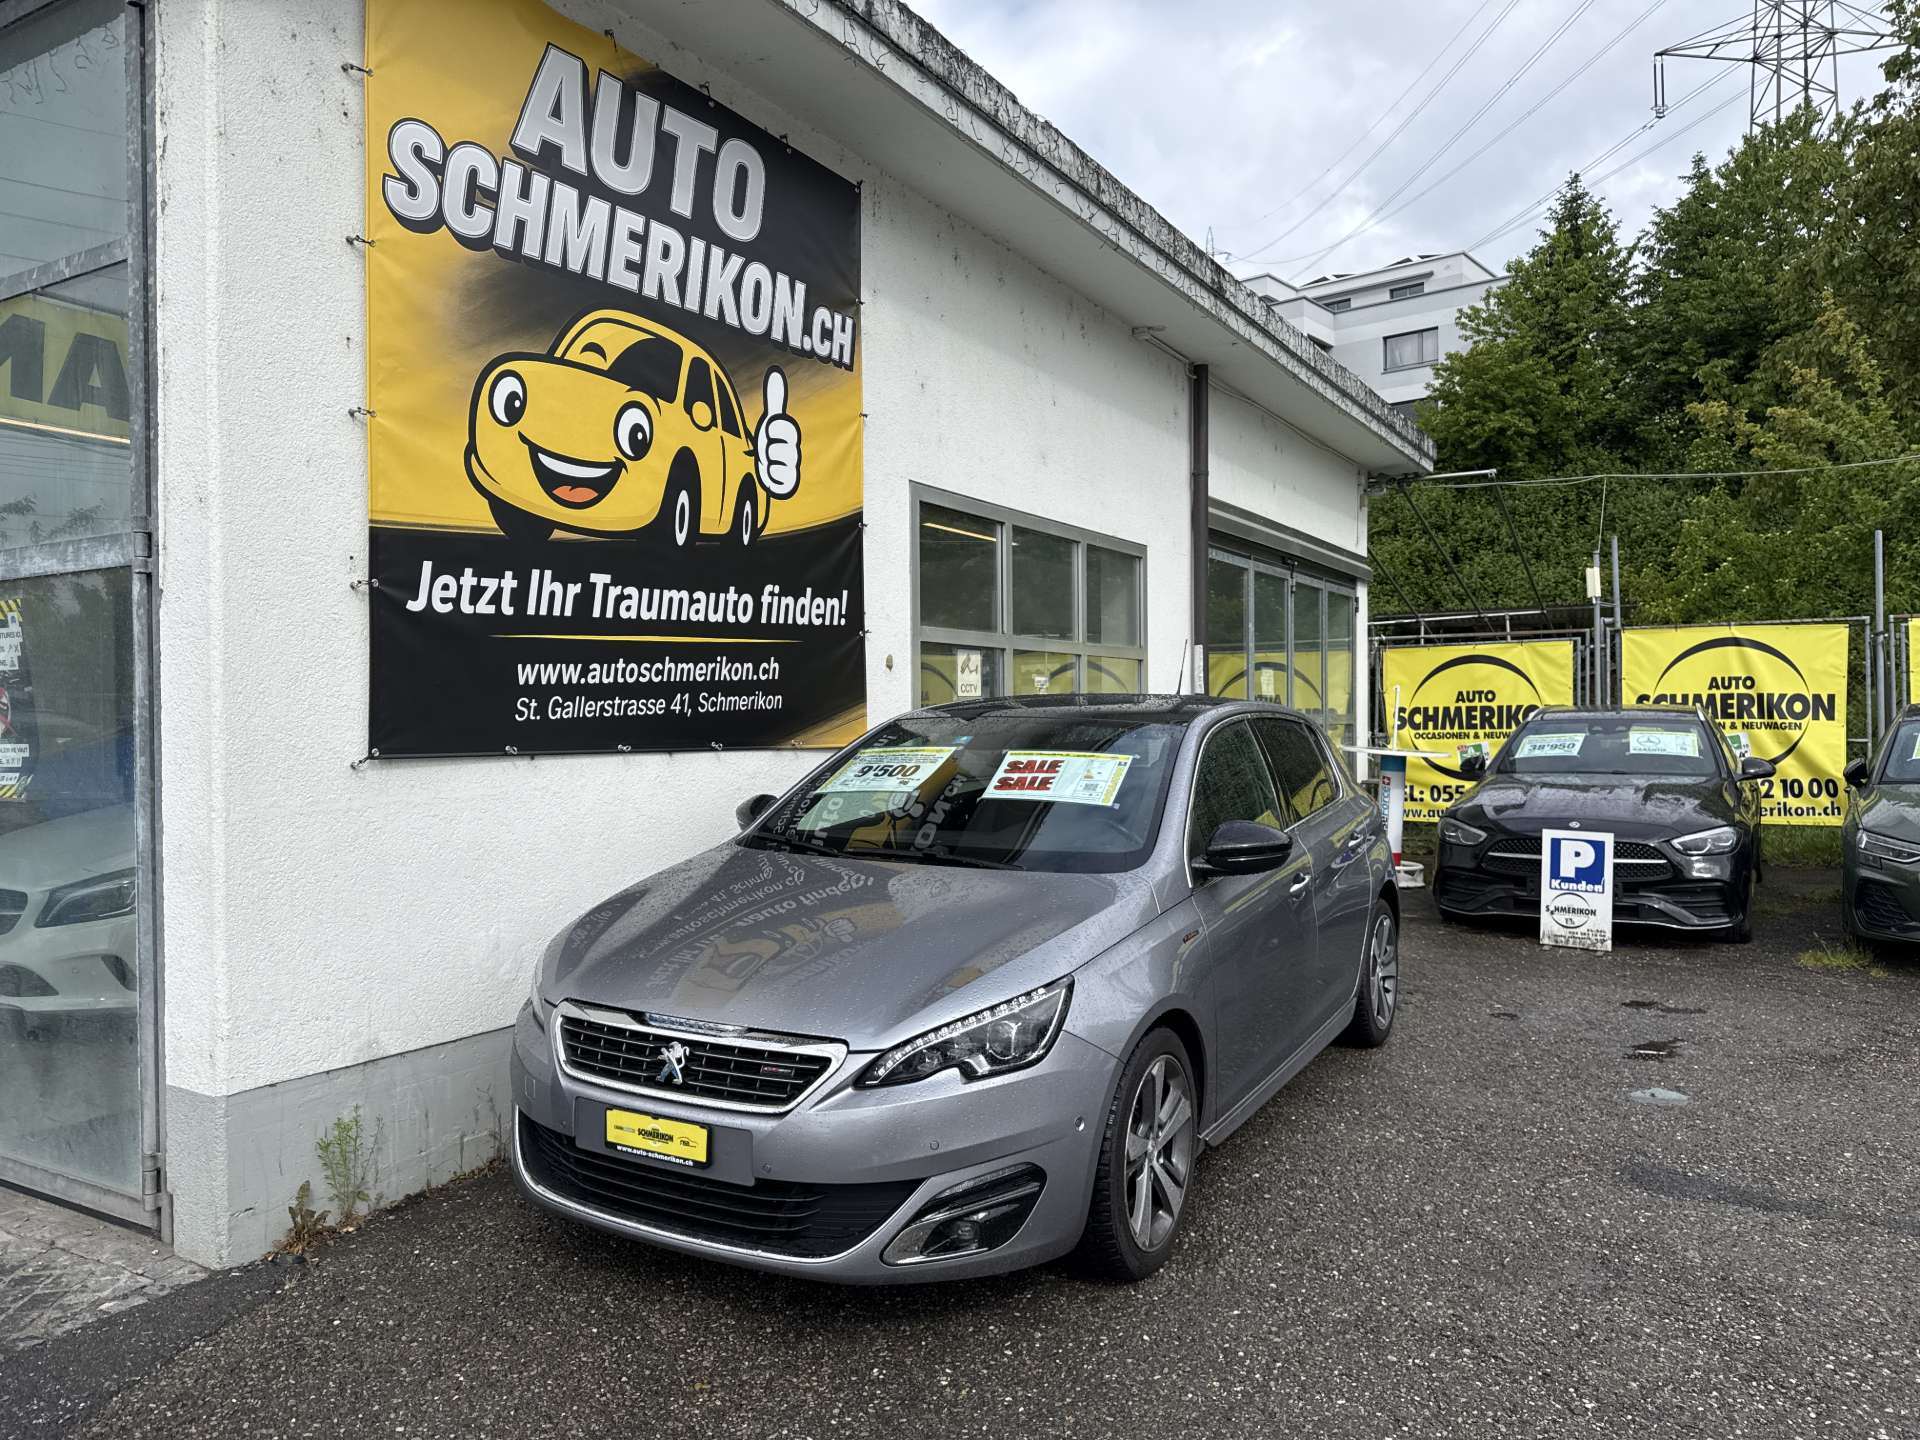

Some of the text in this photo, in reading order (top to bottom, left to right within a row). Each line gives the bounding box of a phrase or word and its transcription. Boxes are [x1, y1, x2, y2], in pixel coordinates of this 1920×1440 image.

[511, 43, 766, 242] AUTO
[384, 119, 854, 368] SCHMERIKON.CH
[405, 560, 848, 627] Jetzt Ihr Traumauto finden!
[517, 656, 779, 685] www.autoschmerikon.ch
[961, 683, 977, 693] CCTV
[1708, 676, 1755, 690] AUTO
[1455, 690, 1496, 703] AUTO
[514, 691, 782, 722] St. Gallerstrasse 41, Schmerikon
[1742, 721, 1803, 730] NEUWAGEN
[1414, 732, 1470, 740] OCCASIONEN
[1473, 731, 1480, 740] &
[854, 764, 920, 777] 9'500
[1003, 760, 1065, 774] SALE
[993, 776, 1057, 791] SALE
[1780, 778, 1804, 798] 10
[1808, 778, 1839, 799] 00
[1560, 840, 1595, 878] P
[1551, 879, 1603, 893] Kunden
[638, 1127, 674, 1143] SCHMERIKON
